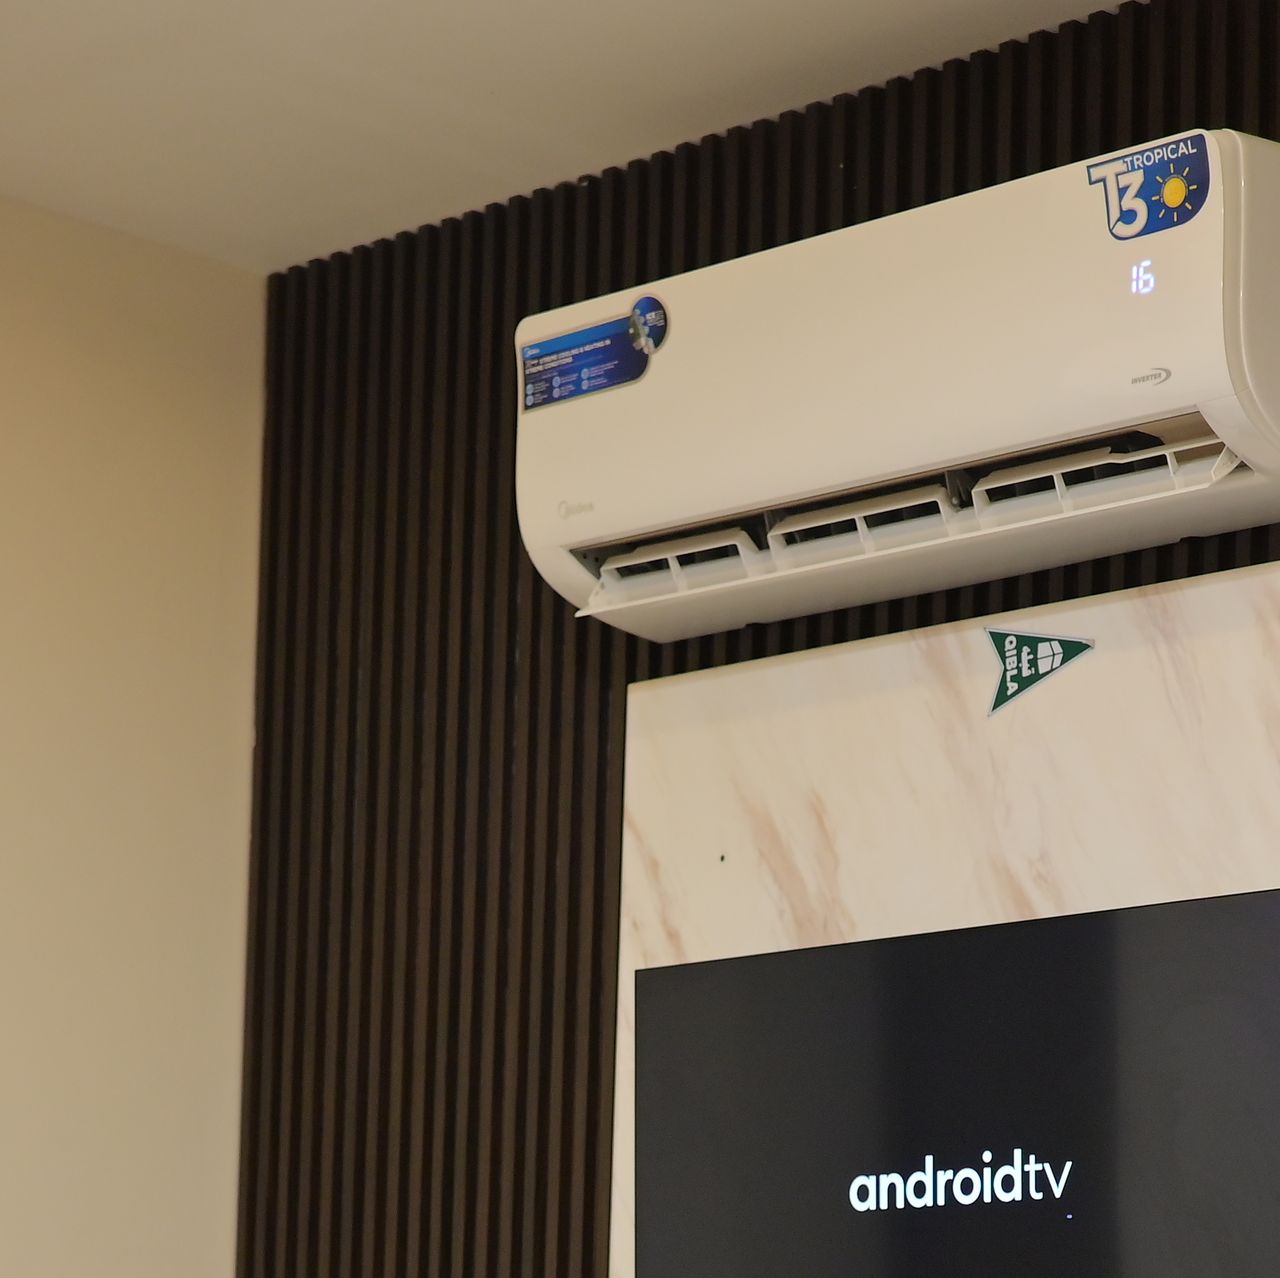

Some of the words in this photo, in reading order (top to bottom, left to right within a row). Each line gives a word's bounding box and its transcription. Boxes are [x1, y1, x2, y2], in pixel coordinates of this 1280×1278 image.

[1124, 139, 1198, 171] TROPICAL
[1087, 160, 1149, 239] T3
[1131, 259, 1155, 294] 16
[1004, 635, 1019, 696] QIBLA
